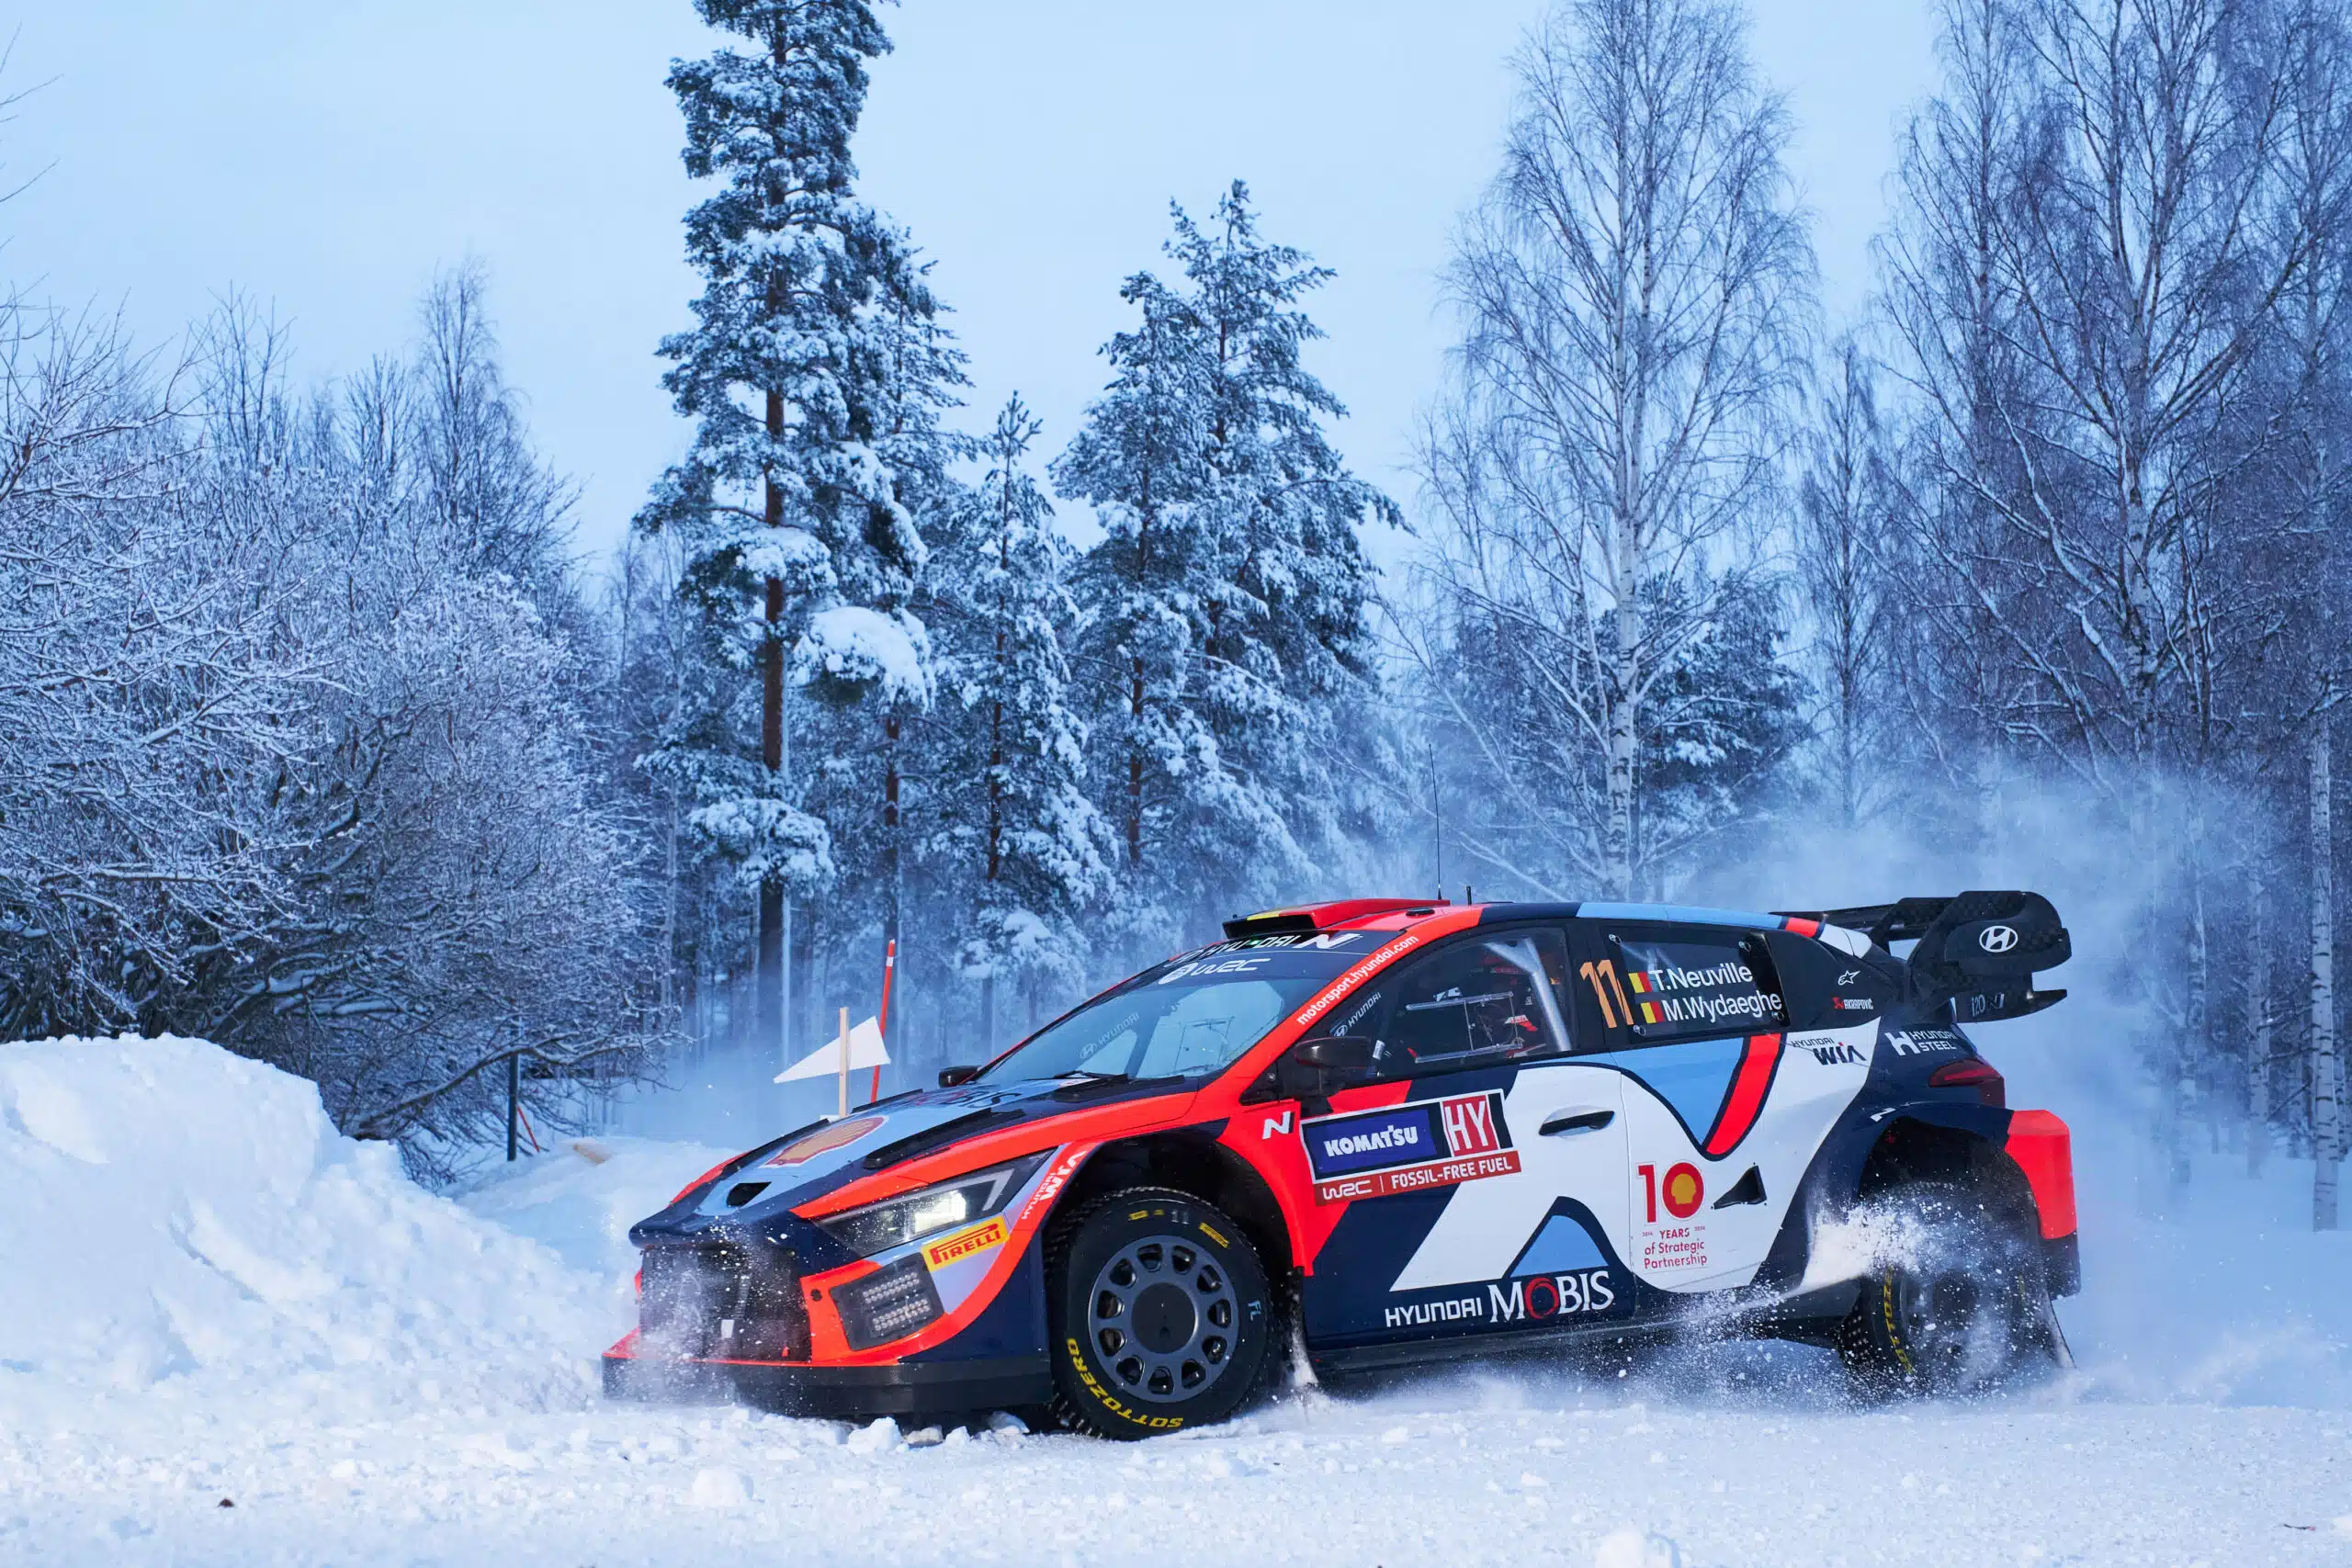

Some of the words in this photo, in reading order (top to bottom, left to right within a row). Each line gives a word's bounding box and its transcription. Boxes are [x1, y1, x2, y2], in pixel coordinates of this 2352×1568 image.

[1198, 934, 1301, 957] HYUDAI
[1191, 958, 1272, 976] WRC
[1296, 935, 1419, 1025] motorsport.hyundai.com
[1649, 963, 1753, 991] T.Neuville
[1348, 992, 1382, 1027] HYUNDAI
[1579, 959, 1634, 1029] 11
[1661, 990, 1783, 1022] M.Wydaeghe
[1098, 1012, 1139, 1045] HYUNDAI
[1792, 1037, 1835, 1048] HYUNDAI
[1909, 1029, 1957, 1040] HYUNDAI
[1813, 1042, 1867, 1066] WIA
[1920, 1040, 1957, 1052] STEEL
[1324, 1124, 1419, 1157] KOMATSU
[1443, 1100, 1490, 1151] HY
[1322, 1179, 1373, 1200] WRC
[1391, 1161, 1476, 1190] FOSSIL-FREE
[1479, 1156, 1513, 1176] FUEL
[1638, 1162, 1705, 1224] 10
[1021, 1172, 1057, 1220] HYUNDAI
[929, 1223, 1001, 1265] PIRELLI
[1645, 1242, 1656, 1255] of
[1658, 1237, 1705, 1254] Strategic
[1659, 1227, 1690, 1239] YEARS
[1644, 1252, 1707, 1269] Partnership
[1385, 1297, 1483, 1327] HYUNDAI
[1487, 1270, 1615, 1323] MOBIS
[1066, 1337, 1184, 1428] SOTTOZERO
